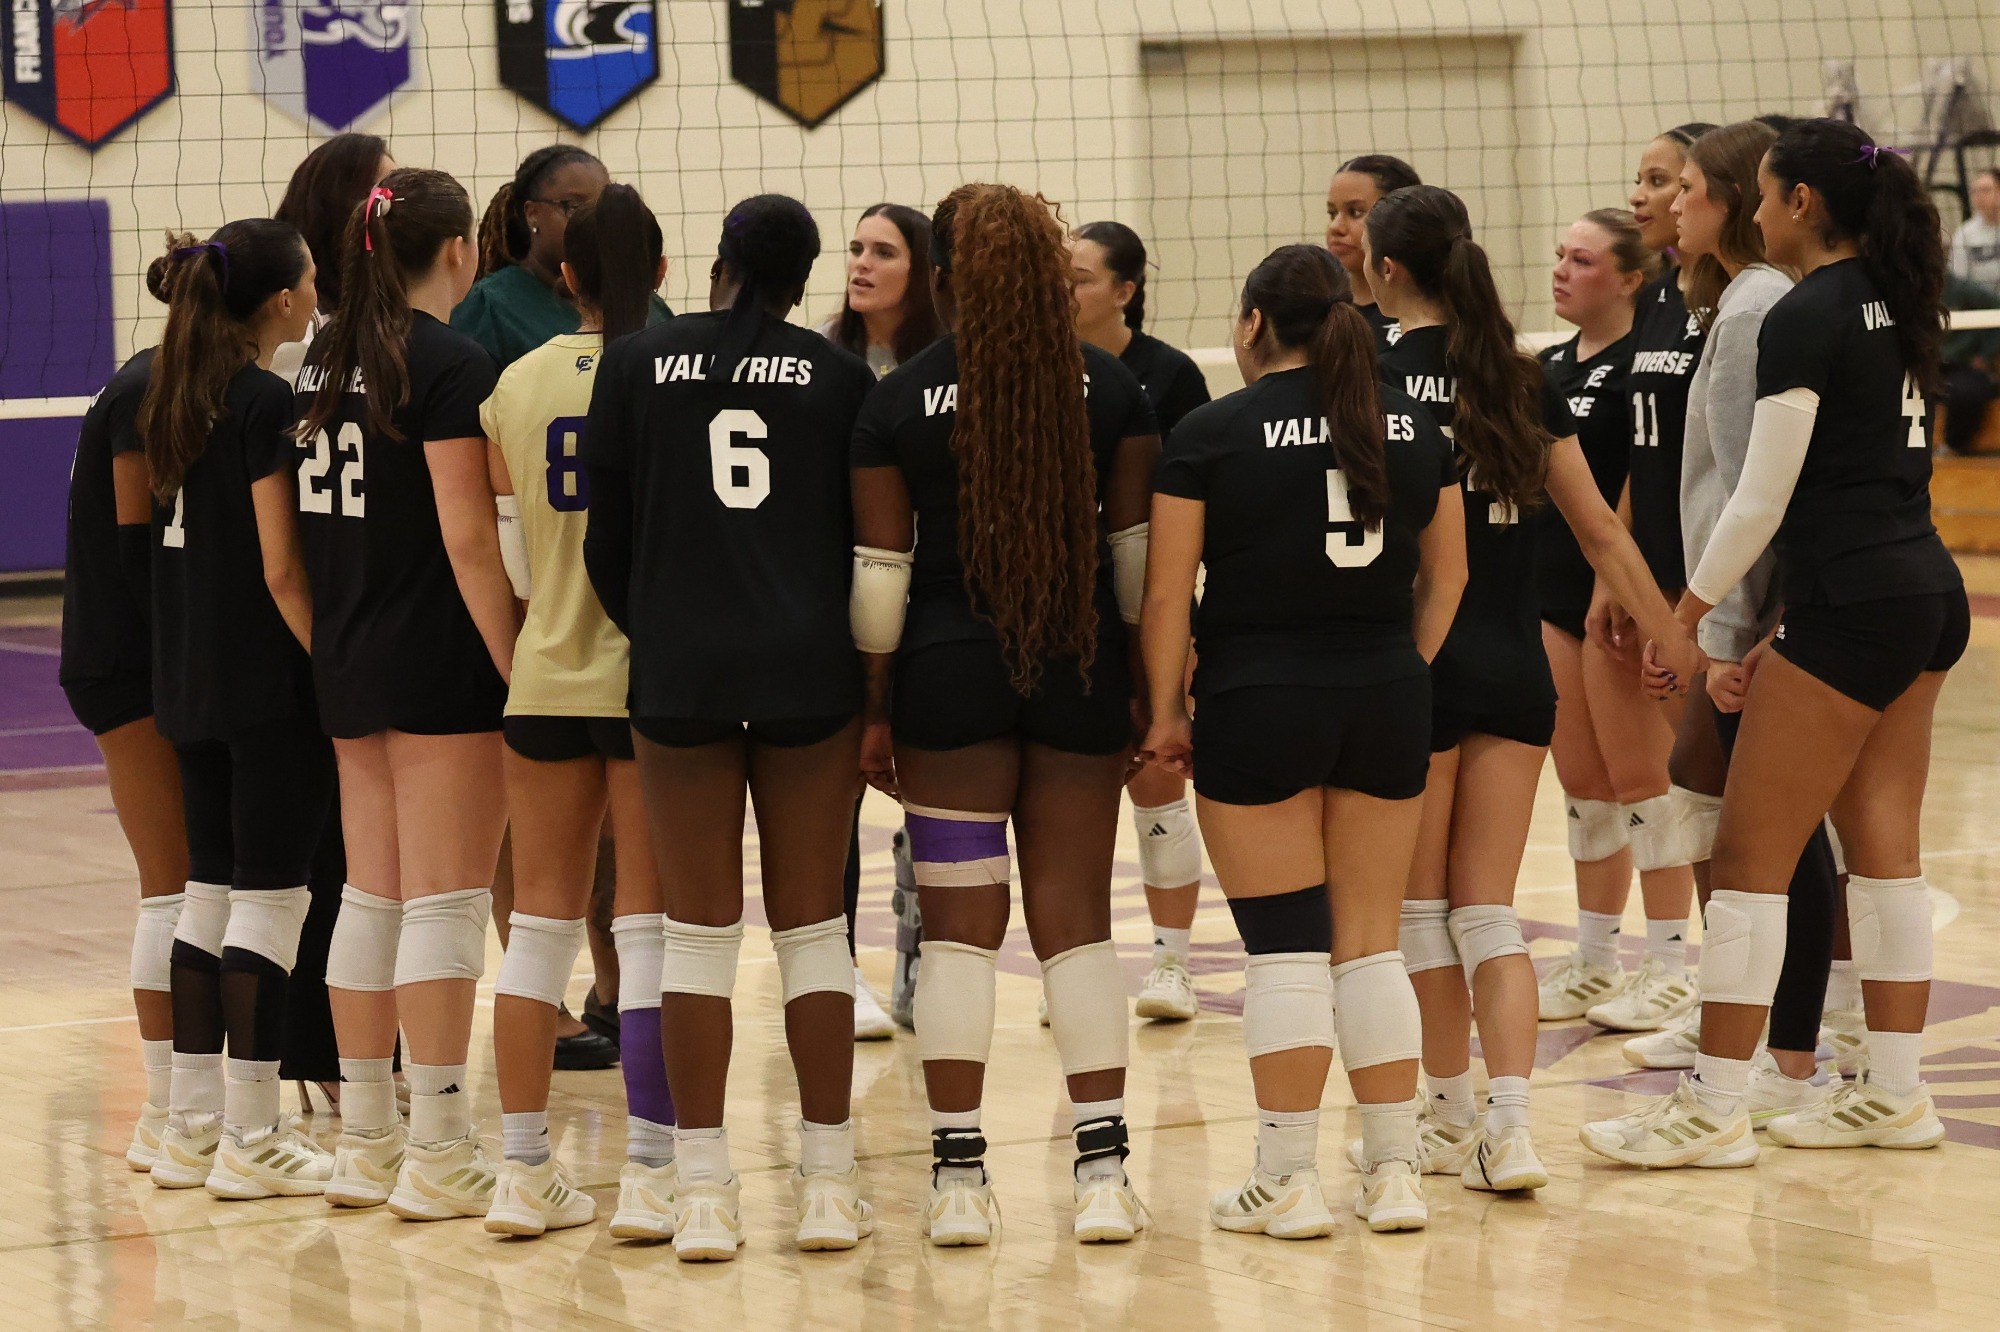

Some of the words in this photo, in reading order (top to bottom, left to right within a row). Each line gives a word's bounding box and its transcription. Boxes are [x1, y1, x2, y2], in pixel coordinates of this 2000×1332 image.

[1862, 301, 1896, 331] VAL
[654, 353, 813, 386] VALYRIES
[1901, 369, 1926, 448] 4
[1263, 414, 1415, 448] VALKES
[1632, 391, 1659, 447] 11
[295, 419, 365, 518] 22
[545, 416, 588, 513] 8
[708, 409, 770, 509] 6
[1325, 468, 1384, 568] 5
